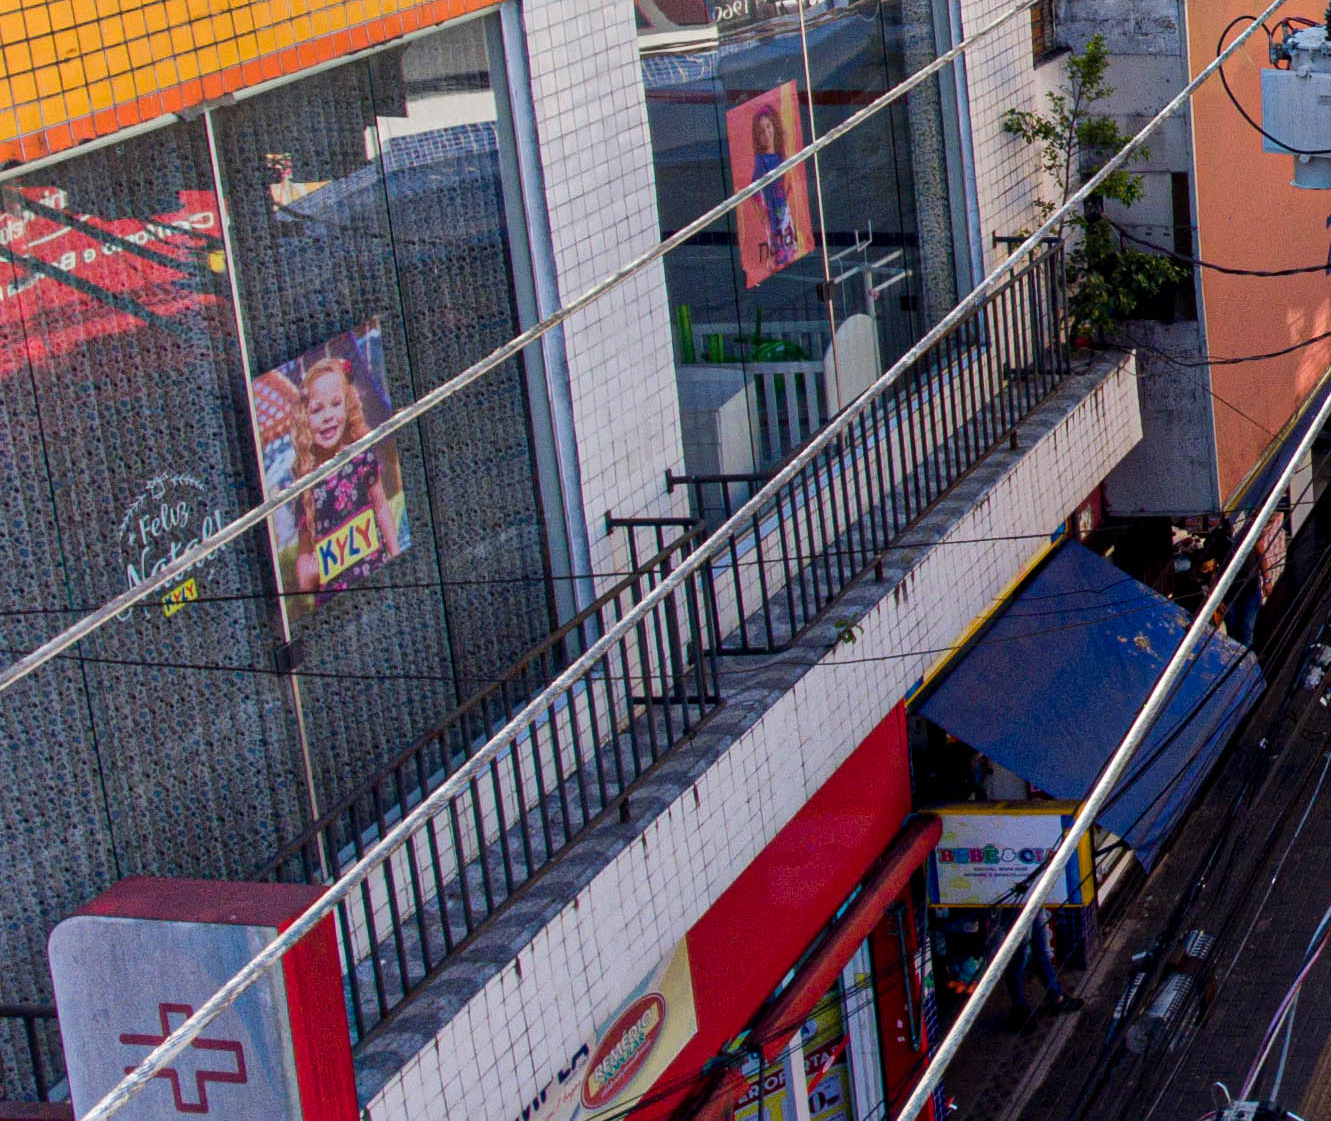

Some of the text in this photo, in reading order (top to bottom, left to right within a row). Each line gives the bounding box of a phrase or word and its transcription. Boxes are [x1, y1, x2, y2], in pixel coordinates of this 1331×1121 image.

[319, 517, 373, 576] KYLY
[165, 582, 196, 611] KYLY
[936, 843, 1000, 864] BEBÊ
